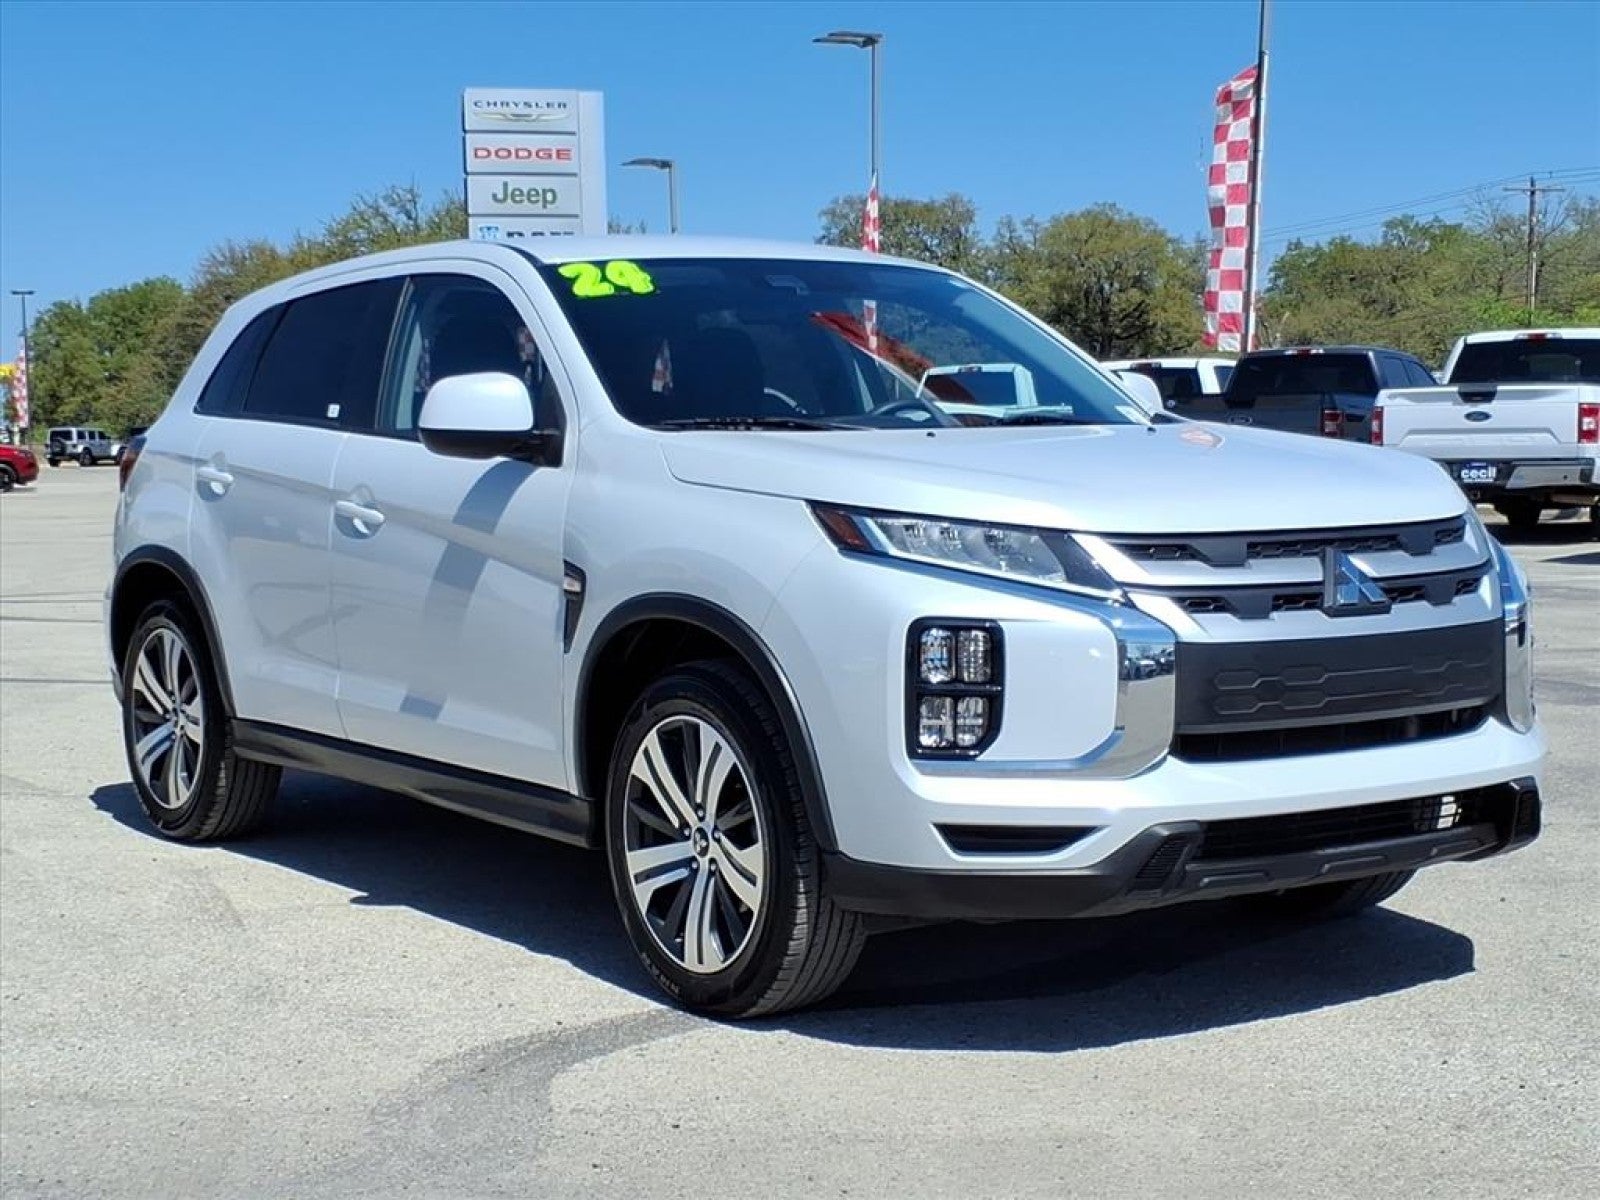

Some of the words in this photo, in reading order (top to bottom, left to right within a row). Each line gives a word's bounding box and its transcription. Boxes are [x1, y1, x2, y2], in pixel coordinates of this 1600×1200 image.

[473, 100, 567, 109] CHRYSLER
[474, 147, 572, 160] DODGE
[492, 181, 558, 209] Jeep
